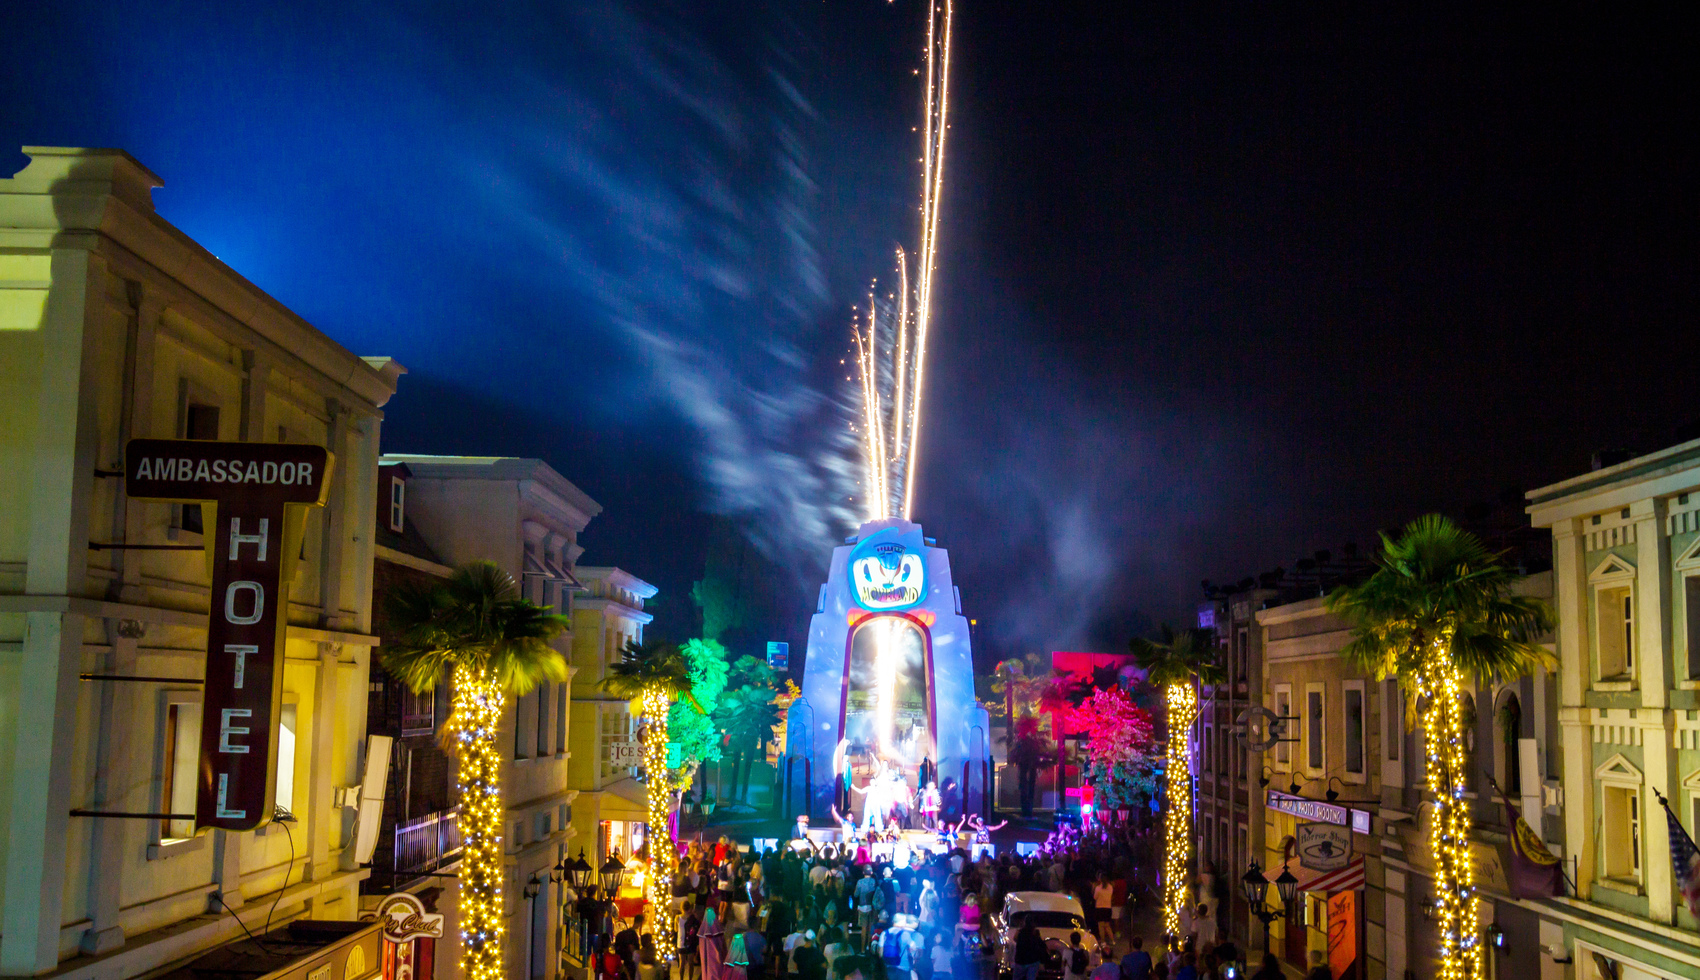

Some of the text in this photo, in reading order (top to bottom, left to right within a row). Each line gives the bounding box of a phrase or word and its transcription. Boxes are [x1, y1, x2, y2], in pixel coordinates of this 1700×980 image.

[136, 457, 313, 486] AMBASSADOR
[215, 517, 269, 819] HOTEL
[615, 747, 634, 760] ICE
[1298, 802, 1314, 816] PHOTO
[1316, 806, 1342, 824] SHOOTING
[1301, 830, 1349, 849] Horror Shop
